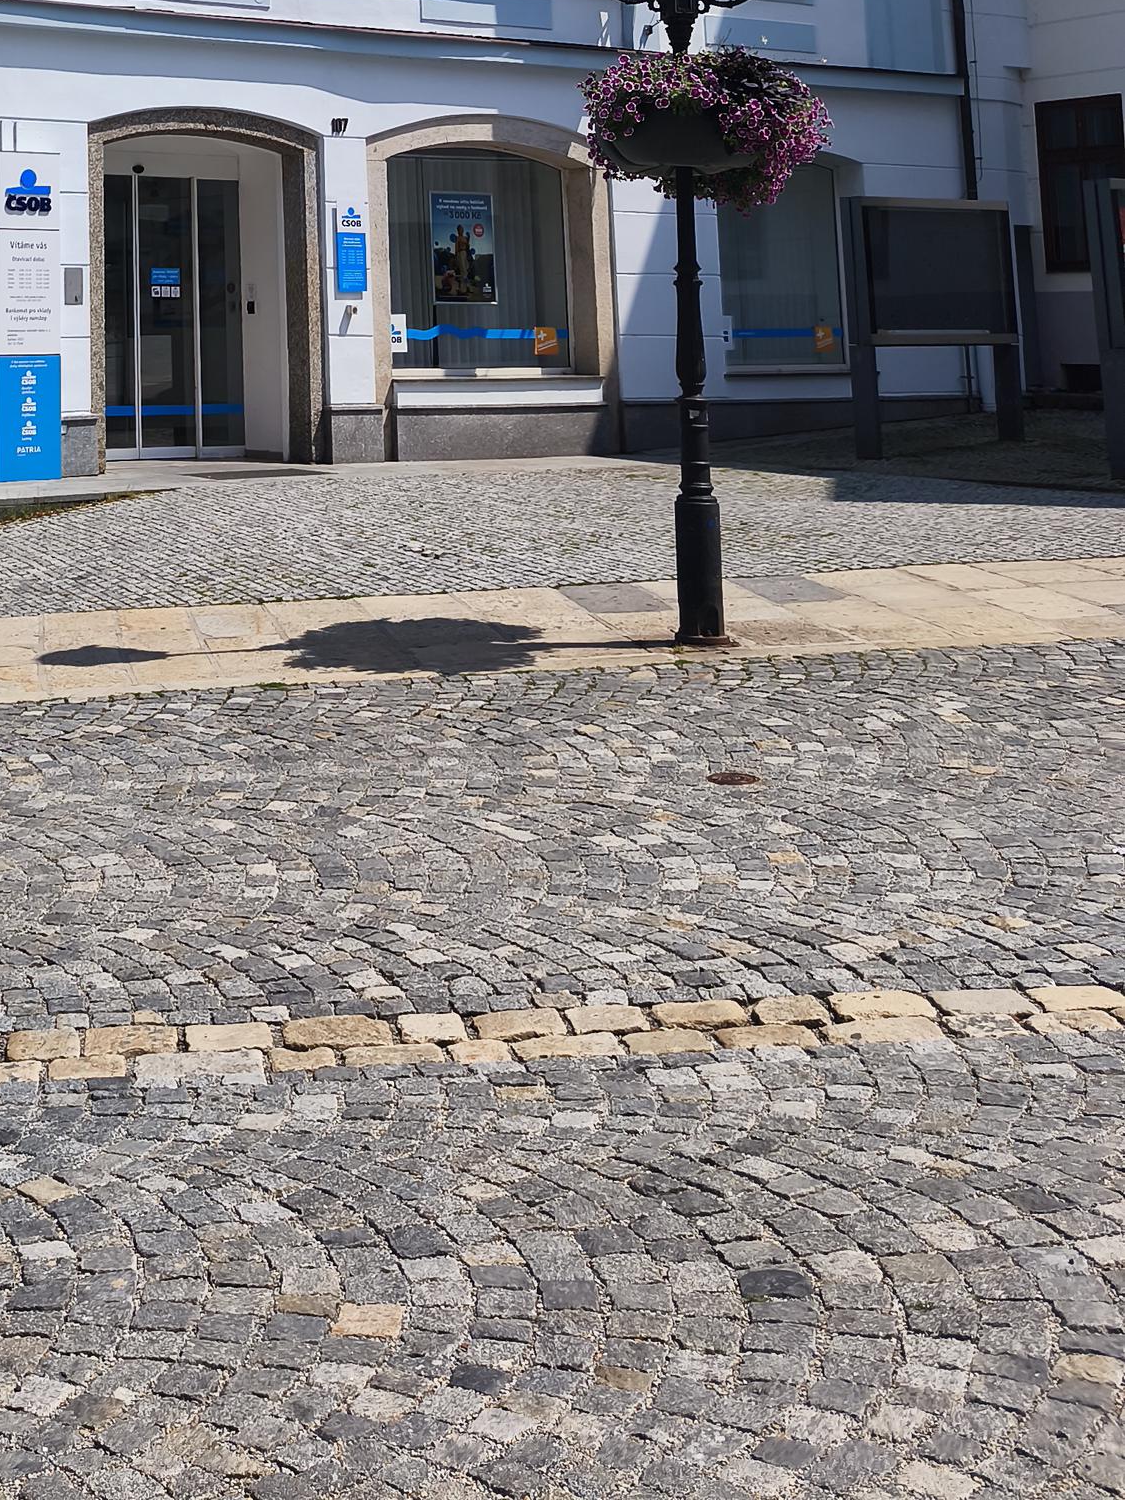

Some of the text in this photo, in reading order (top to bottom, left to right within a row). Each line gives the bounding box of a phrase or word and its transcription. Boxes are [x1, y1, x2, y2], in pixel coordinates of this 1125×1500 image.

[331, 117, 348, 133] 107
[6, 194, 52, 212] ČSOB
[341, 219, 362, 227] ČSOB
[10, 241, 47, 250] Vítáme vás
[17, 446, 42, 454] PATRIA
